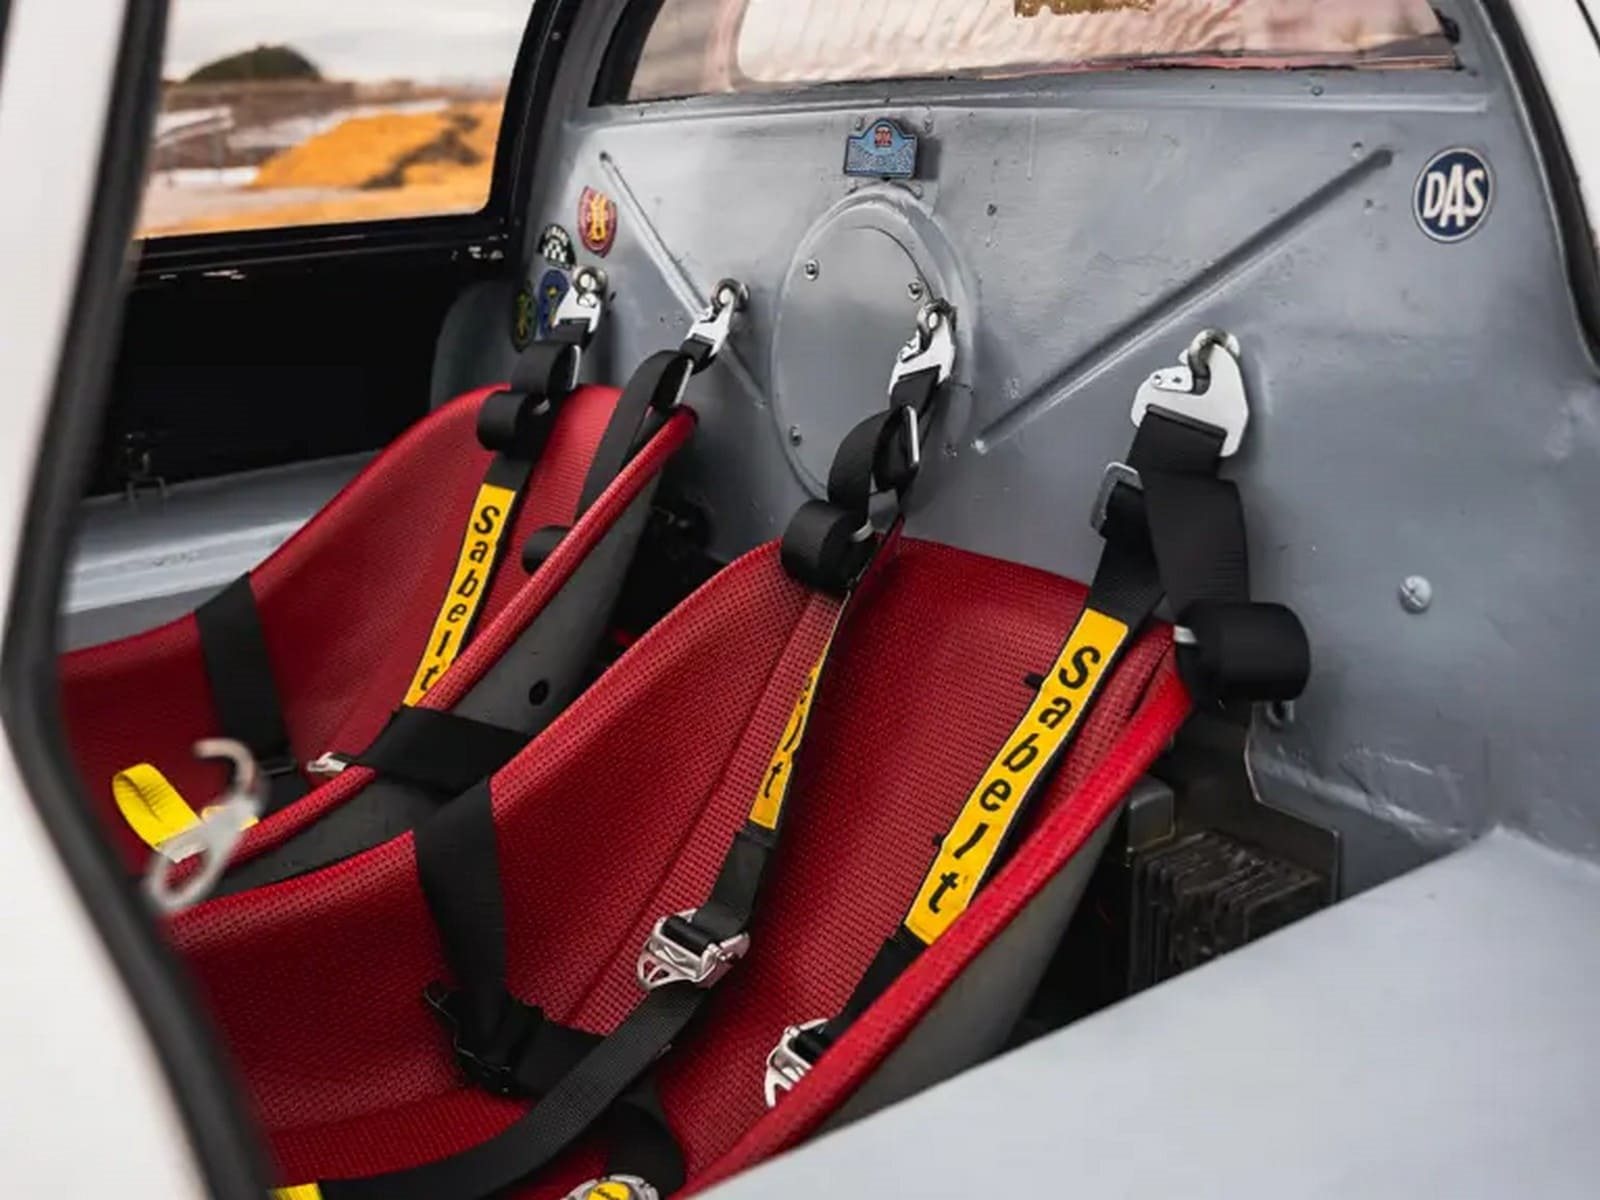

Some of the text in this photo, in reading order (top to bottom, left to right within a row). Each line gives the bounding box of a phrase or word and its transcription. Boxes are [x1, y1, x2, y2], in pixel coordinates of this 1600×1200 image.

[1423, 163, 1484, 227] DAS
[420, 505, 500, 691] Sabelt
[928, 645, 1101, 914] Sabelt
